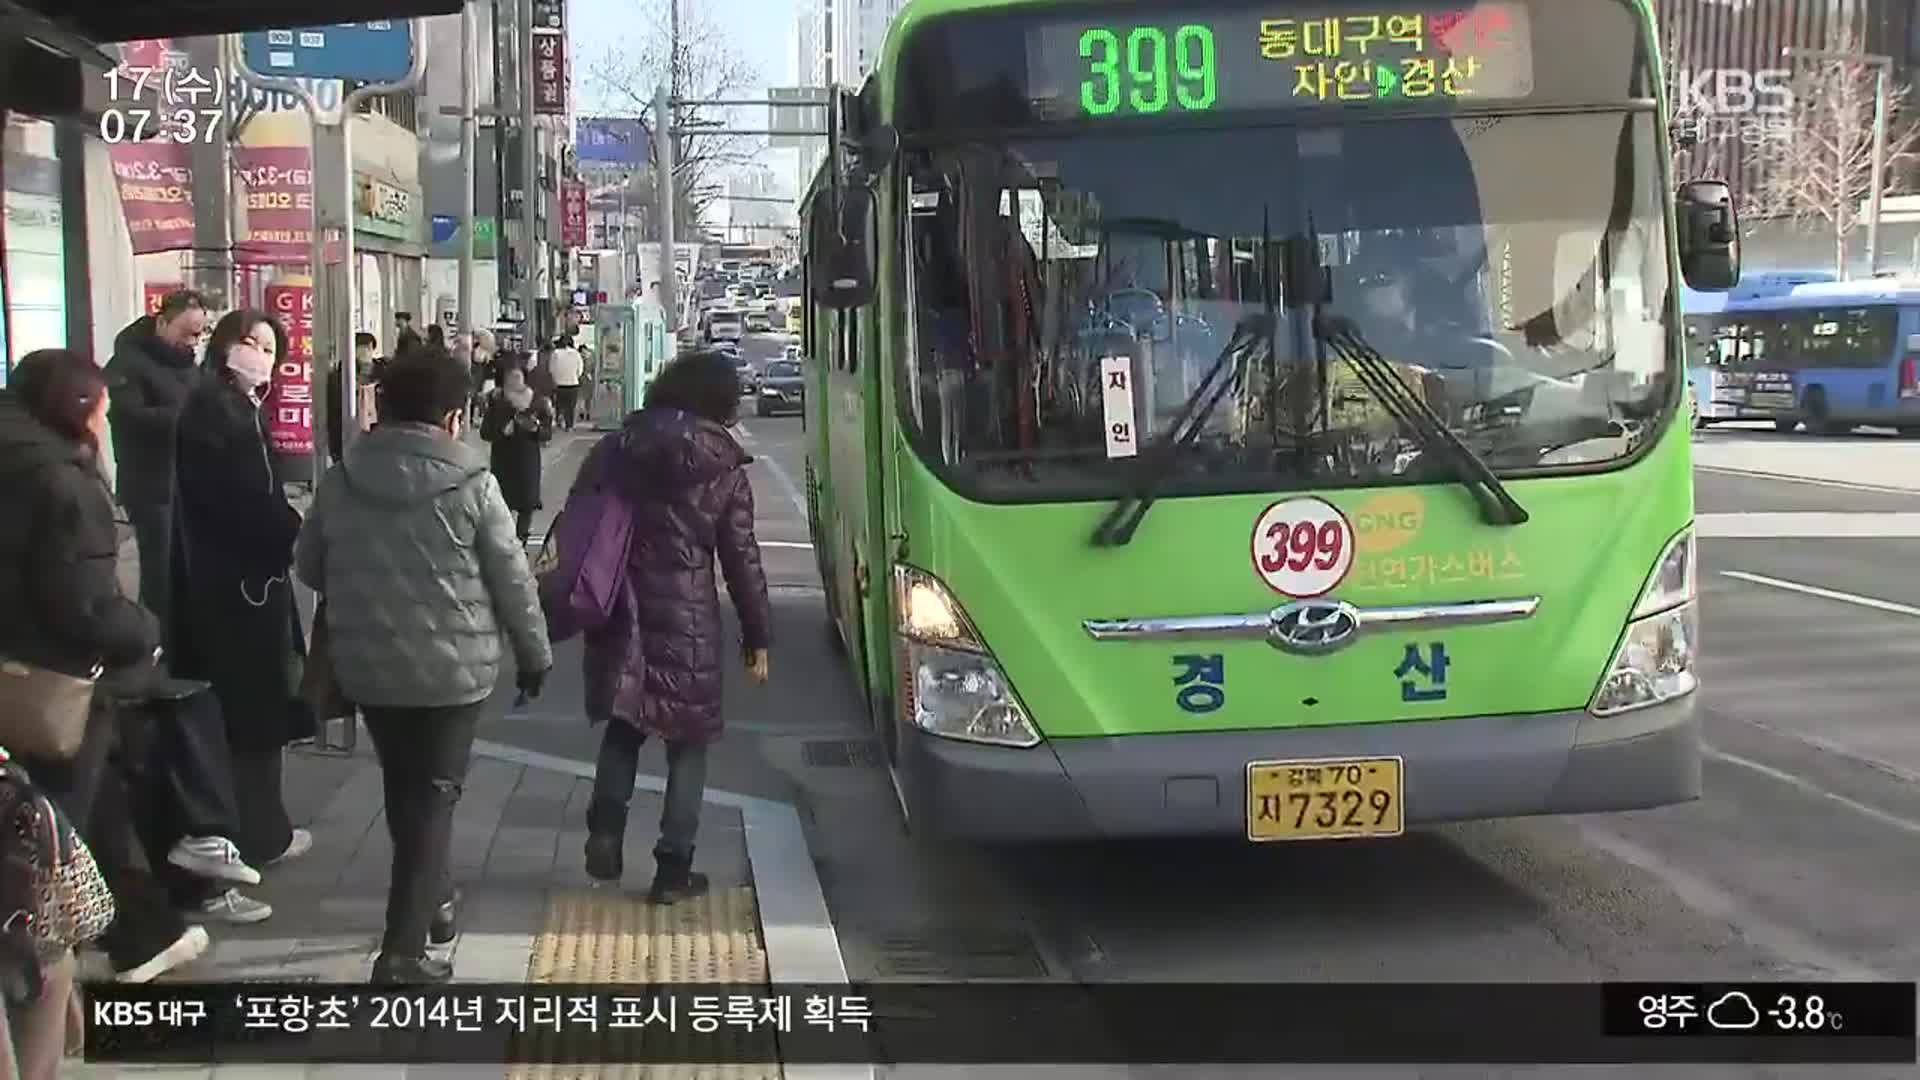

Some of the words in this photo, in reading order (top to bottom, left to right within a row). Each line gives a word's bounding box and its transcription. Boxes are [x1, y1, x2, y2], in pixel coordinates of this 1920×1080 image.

[1259, 14, 1424, 58] 동대구역
[1080, 25, 1215, 113] 399
[1293, 57, 1373, 101] 자인
[1401, 54, 1482, 98] 경산
[1261, 520, 1343, 572] 399
[1172, 654, 1225, 713] 경
[1393, 642, 1450, 702] 산
[1328, 766, 1361, 784] 70
